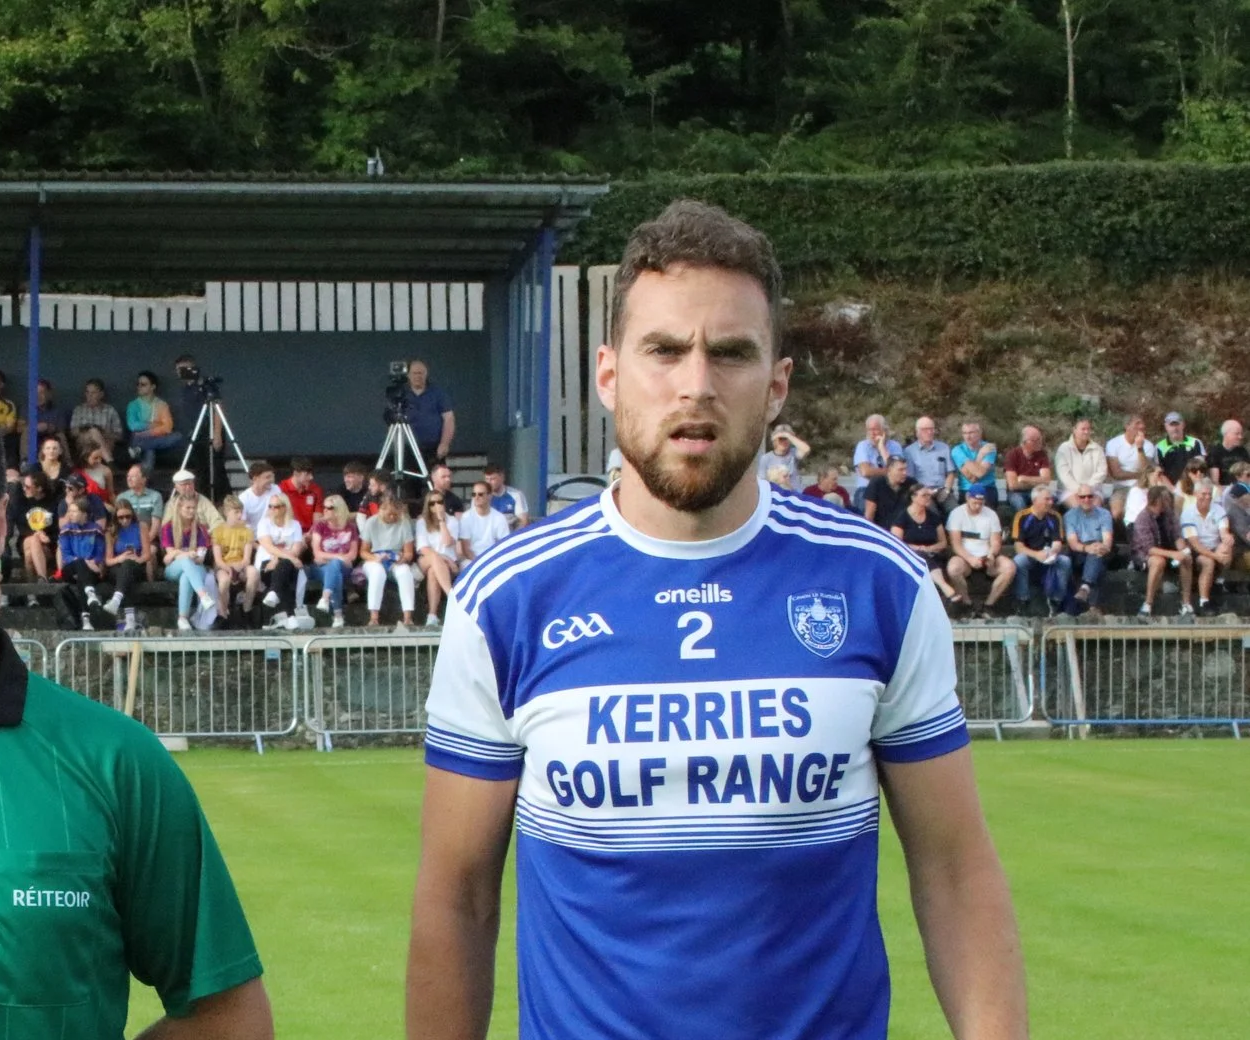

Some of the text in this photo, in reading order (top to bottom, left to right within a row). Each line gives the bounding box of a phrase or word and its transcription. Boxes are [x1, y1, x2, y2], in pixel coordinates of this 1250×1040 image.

[676, 610, 716, 660] 2
[587, 687, 812, 745] KERRIES
[547, 752, 851, 809] GOLF RANGE
[12, 886, 91, 909] RÉITEOIR
